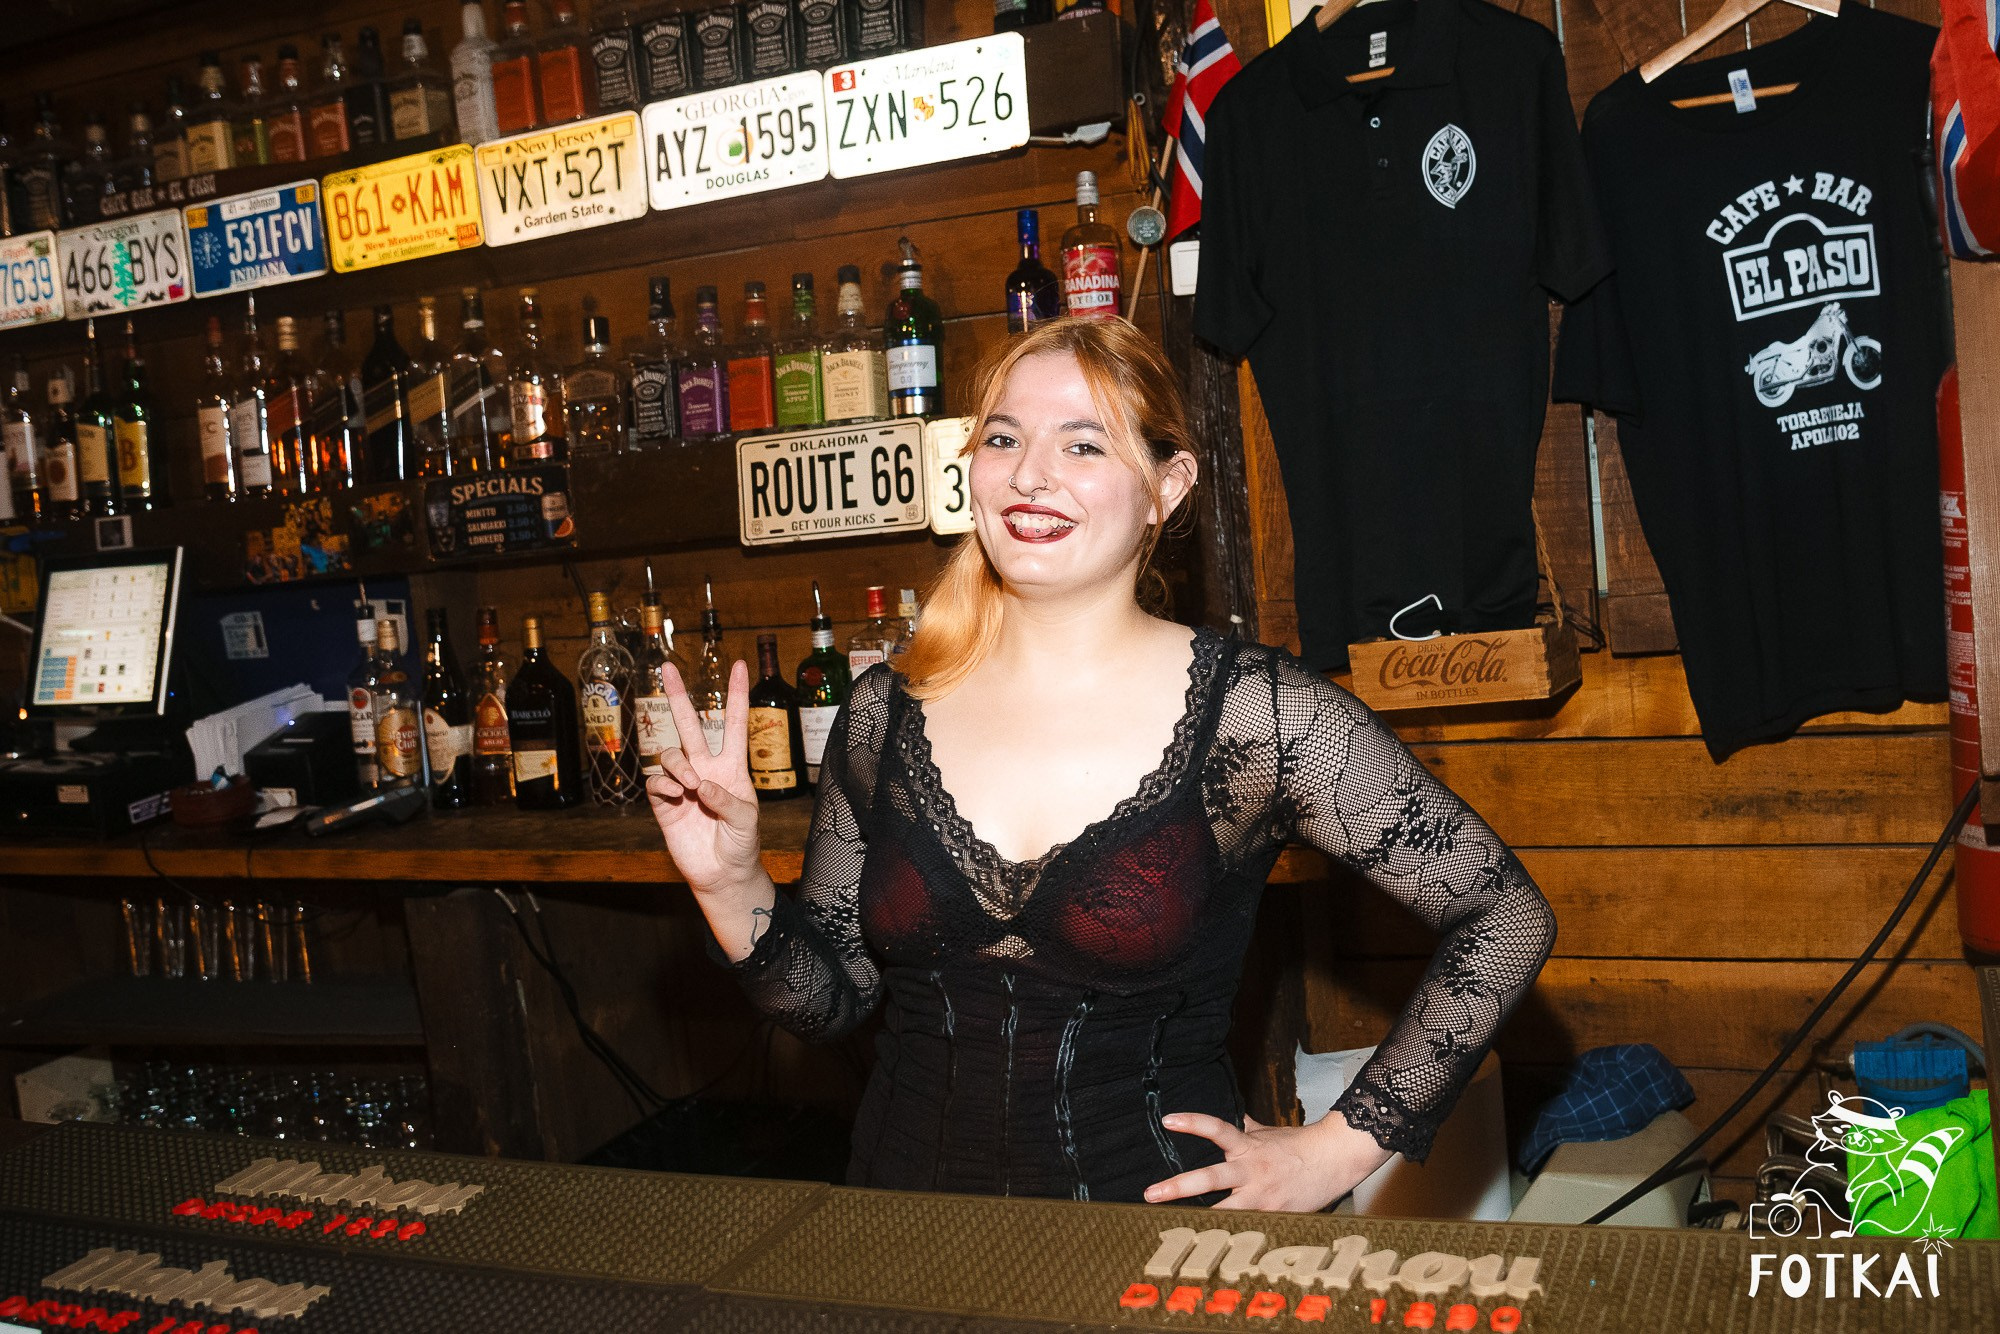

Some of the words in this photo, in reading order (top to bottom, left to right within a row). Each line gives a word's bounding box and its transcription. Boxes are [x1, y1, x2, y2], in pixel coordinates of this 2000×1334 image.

[840, 71, 853, 89] 3
[685, 87, 781, 121] GEORGIA
[837, 90, 907, 149] ZXN
[940, 72, 1013, 130] 526
[515, 140, 549, 157] New
[552, 130, 597, 153] Jersey
[657, 125, 711, 181] AYZ
[740, 103, 817, 164] 1595
[492, 157, 547, 214] VXT
[565, 141, 625, 199] 52T
[706, 168, 770, 189] DOUGLAS
[333, 182, 391, 242] 861
[407, 164, 466, 226] KAM
[524, 212, 568, 228] Garden
[572, 202, 604, 218] State
[1705, 180, 1781, 245] CAFE
[1811, 171, 1872, 217] BAR
[225, 207, 313, 265] 531FCV
[66, 246, 113, 296] 466
[128, 232, 179, 285] BYS
[230, 260, 287, 284] INDIANA
[1735, 256, 1785, 308] EL
[1783, 238, 1870, 296] PASO
[790, 434, 868, 452] OKLAHOMA
[451, 476, 544, 506] SPECIALS
[750, 450, 858, 518] ROUTE
[871, 443, 915, 508] 66
[791, 519, 810, 532] GET
[813, 516, 841, 530] YOUR
[844, 513, 876, 527] KICKS
[1417, 643, 1446, 653] DRINK
[1417, 691, 1429, 700] IN
[1431, 687, 1478, 699] BOTTLES
[1143, 1226, 1543, 1300] Mahou
[1119, 1282, 1332, 1322] DESDE
